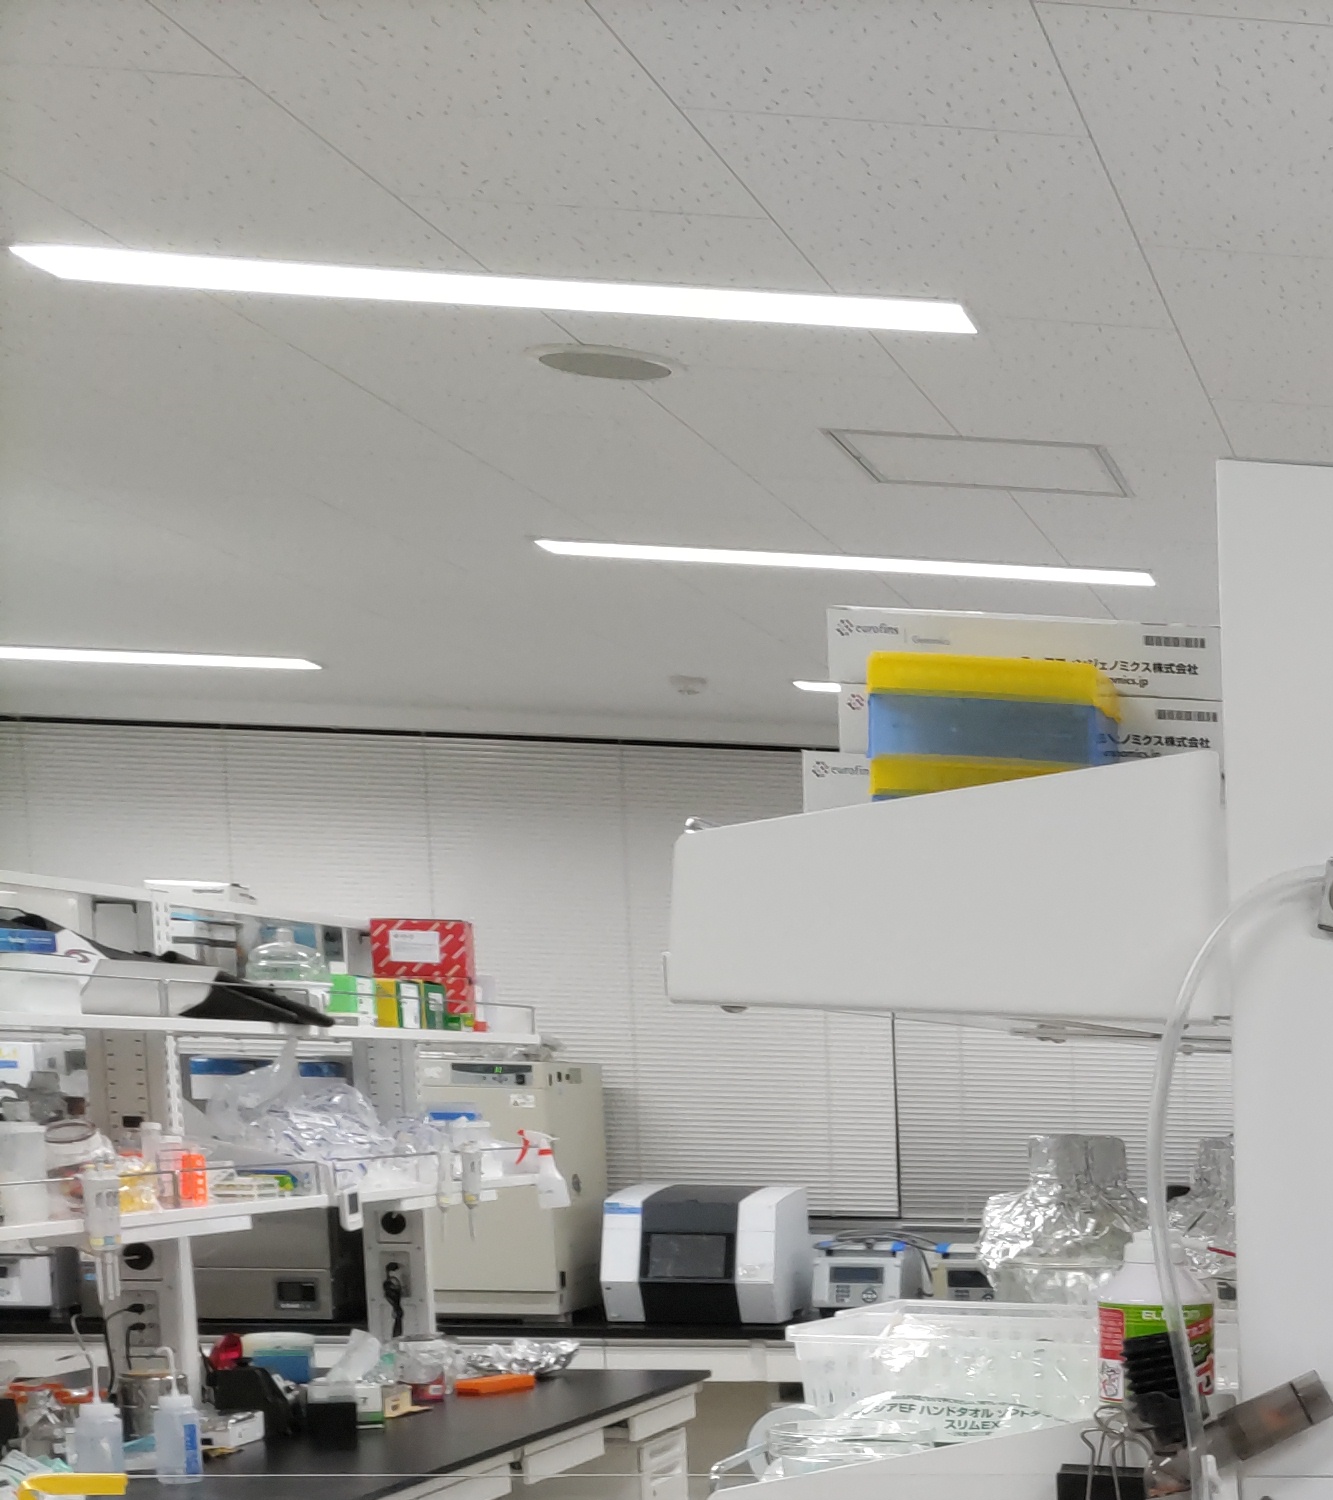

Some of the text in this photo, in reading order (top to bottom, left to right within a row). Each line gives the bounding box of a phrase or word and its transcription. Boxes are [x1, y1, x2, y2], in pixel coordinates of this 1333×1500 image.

[918, 1405, 994, 1418] ハンドタオル
[944, 1419, 1001, 1431] スリムEX
